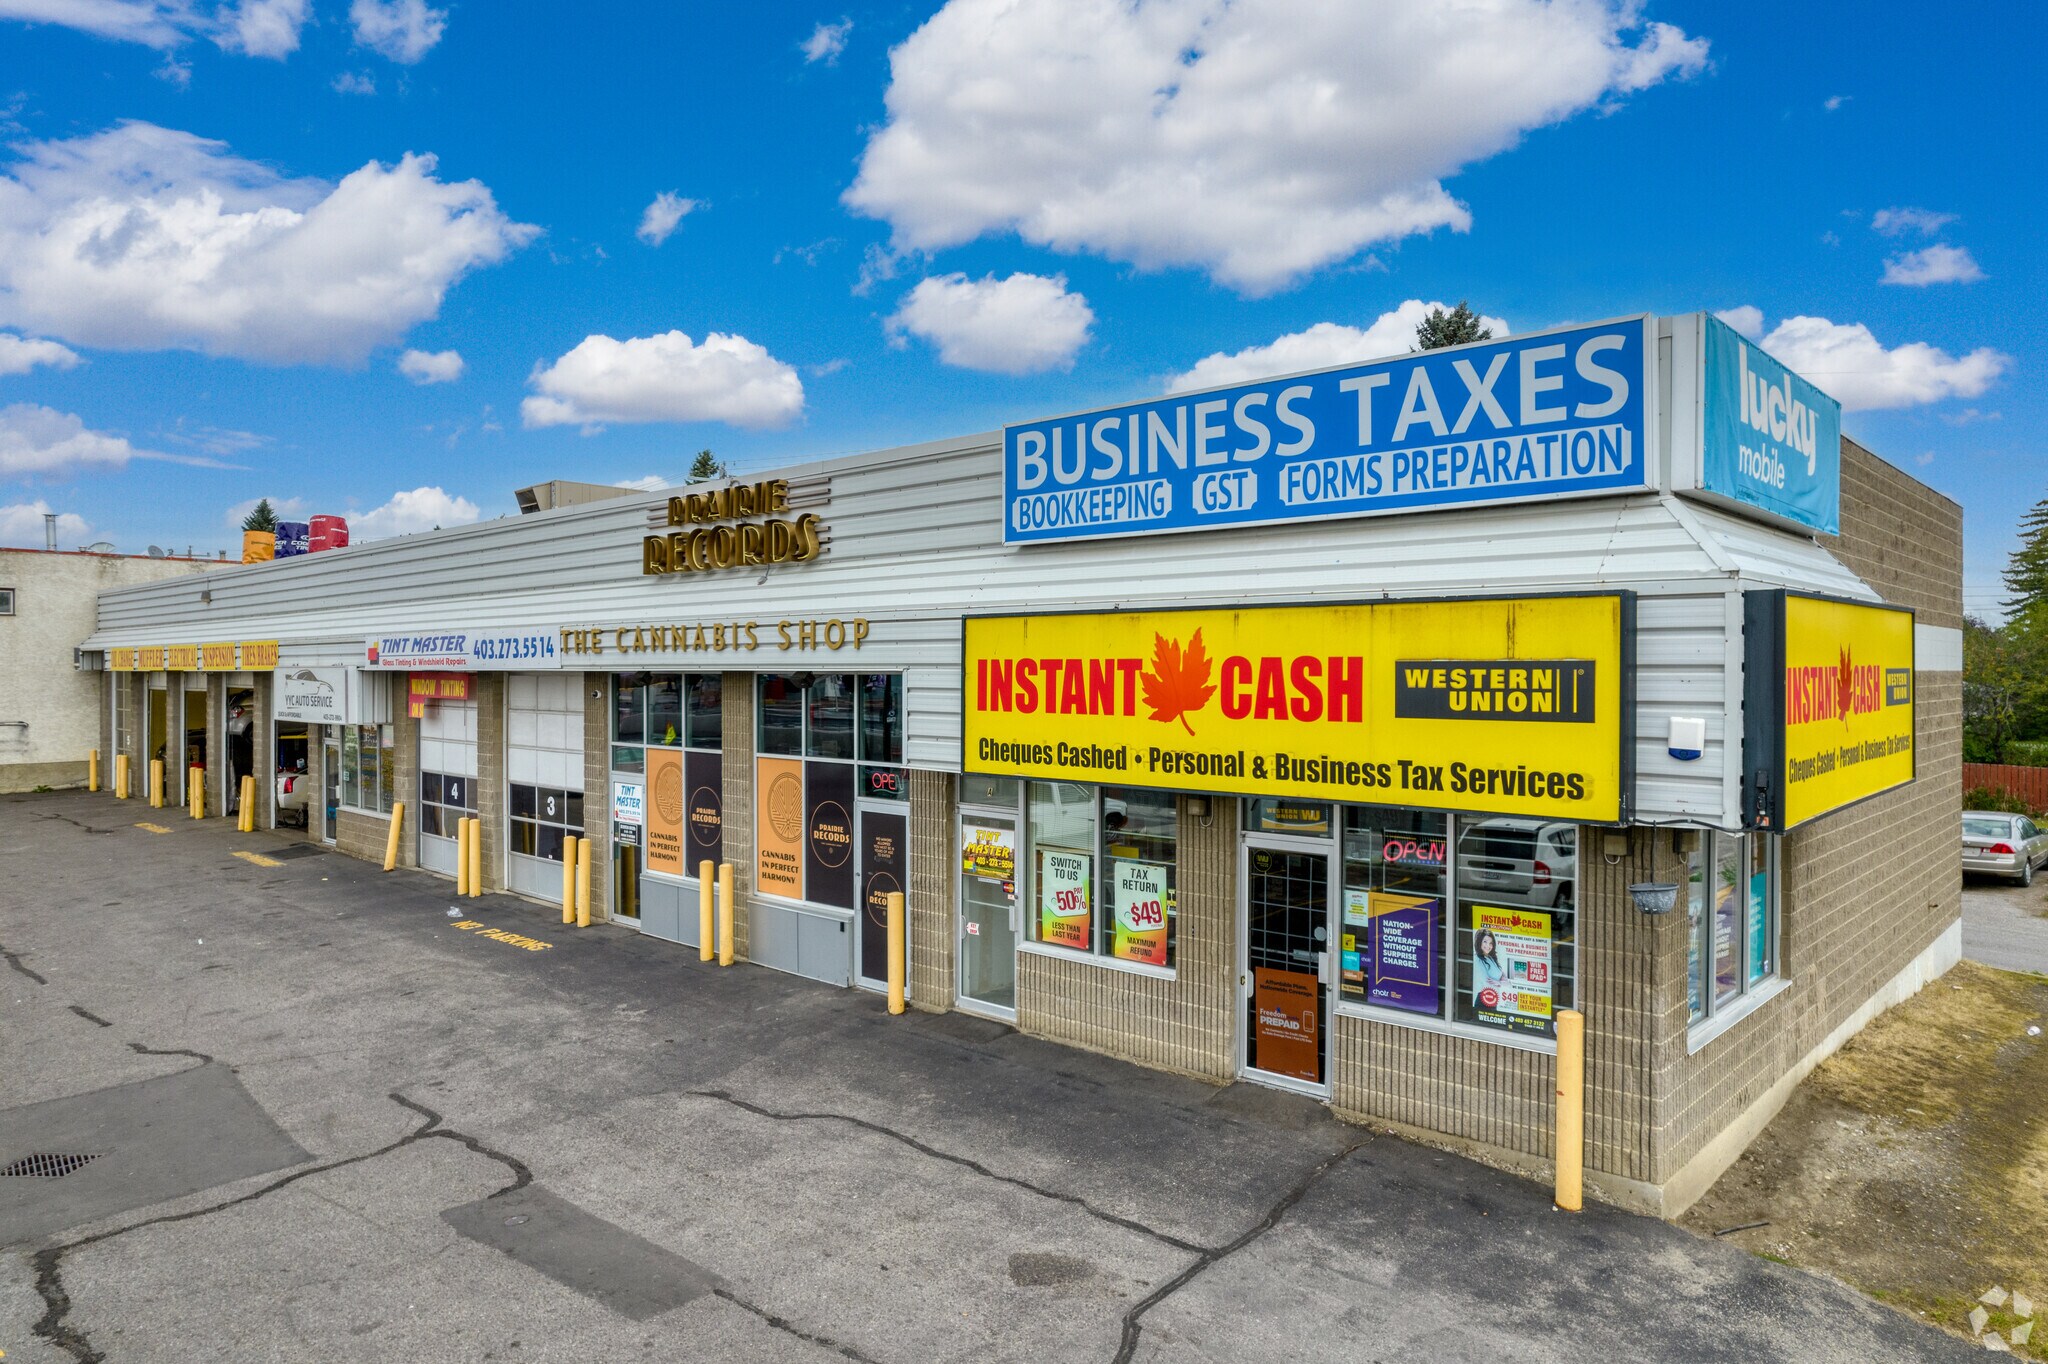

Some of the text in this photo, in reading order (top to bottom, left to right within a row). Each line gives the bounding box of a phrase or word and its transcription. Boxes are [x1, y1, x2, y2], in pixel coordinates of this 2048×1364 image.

[1016, 334, 1630, 491] BUSINESS TAXES
[1738, 341, 1816, 477] lucky
[1286, 426, 1623, 504] FORMS PREPARATION
[1738, 443, 1786, 490] mobile
[1202, 472, 1249, 512] GST
[667, 479, 789, 527] PRAIRIE
[1018, 480, 1165, 531] BOOKKEEPING
[642, 512, 821, 576] RECORDS
[560, 617, 870, 655] THE CANNABIS SHOP
[382, 635, 467, 654] TINT MASTER
[473, 636, 555, 660] 403.273.5514
[138, 649, 164, 668] MUFFLER
[168, 647, 197, 668] ELECTRICAL
[202, 645, 235, 667] SUSPENSION
[241, 643, 278, 666] TIRES BRAKES
[382, 659, 395, 667] Glass
[395, 658, 412, 668] Tinting
[418, 657, 445, 667] Windshield
[446, 657, 467, 667] Repairs
[1404, 668, 1553, 690] WESTERN
[1887, 673, 1908, 686] WESTERN
[411, 679, 465, 698] WINDOW TINTING
[977, 655, 1364, 723] INSTANT CASH
[1787, 664, 1880, 726] INSTANT CASH
[1893, 686, 1908, 700] UNION
[284, 694, 333, 708] YYC AUTO SERVICE
[1449, 690, 1553, 713] UNION
[1788, 756, 1816, 784] Cheques
[1816, 746, 1835, 776] Cashed
[1839, 741, 1861, 768] Personal
[1865, 738, 1887, 761] Business
[1886, 735, 1894, 756] Tax
[1894, 732, 1910, 754] Services
[978, 737, 1585, 801] Cheques Cashed Personal & Business Tax Services
[451, 782, 459, 800] 4
[621, 785, 636, 797] TINT
[987, 787, 993, 797] A
[546, 795, 556, 816] 3
[615, 796, 641, 809] MASTER
[696, 807, 716, 815] PRAIRIE
[1266, 807, 1298, 815] WESTERN
[1301, 809, 1321, 821] WU
[691, 813, 721, 825] RECORDS
[819, 823, 844, 833] PRAIRIE
[650, 831, 678, 843] CANNABIS
[813, 830, 850, 844] RECORDS
[976, 829, 1001, 842] TINT
[657, 843, 681, 853] PERFECT
[967, 842, 1010, 858] MASTER
[1383, 840, 1446, 862] OPEN
[650, 851, 677, 862] HARMONY
[762, 850, 796, 862] CANNABIS
[762, 860, 799, 874] IN PERFECT
[1050, 856, 1082, 870] SWITCH
[762, 871, 796, 884] HARMONY
[1054, 868, 1079, 881] TO US
[1130, 868, 1149, 881] TAX
[1073, 886, 1083, 894] PAY
[1122, 879, 1158, 894] RETURN
[869, 895, 888, 905] RECO
[1130, 900, 1163, 926] $49
[1383, 919, 1414, 930] NATION-
[1481, 914, 1511, 926] INSTANT
[1521, 919, 1543, 930] CASH
[1052, 921, 1081, 933] LESS THAN
[1383, 926, 1402, 936] WIDE
[474, 927, 554, 952] PARKING
[1052, 929, 1081, 941] LAST YEAR
[1383, 934, 1422, 946] COVERAGE
[1126, 936, 1157, 949] MAXIMUM
[1383, 942, 1416, 953] WITHOUT
[1497, 940, 1520, 948] PERSONAL
[1129, 946, 1152, 957] REFUND
[1383, 949, 1417, 961] SURPRISE
[1514, 948, 1547, 957] PREPARATIONS
[1383, 957, 1419, 969] CHARGES.
[1530, 967, 1545, 975] FREE
[1260, 984, 1288, 993] Nationwide
[1265, 979, 1292, 988] Affordable
[1502, 991, 1518, 1003] $49
[1530, 1000, 1547, 1008] REFUND
[1260, 1007, 1287, 1019] Freedom
[1478, 1014, 1507, 1025] WELCOME
[1260, 1015, 1300, 1030] PREPAID
